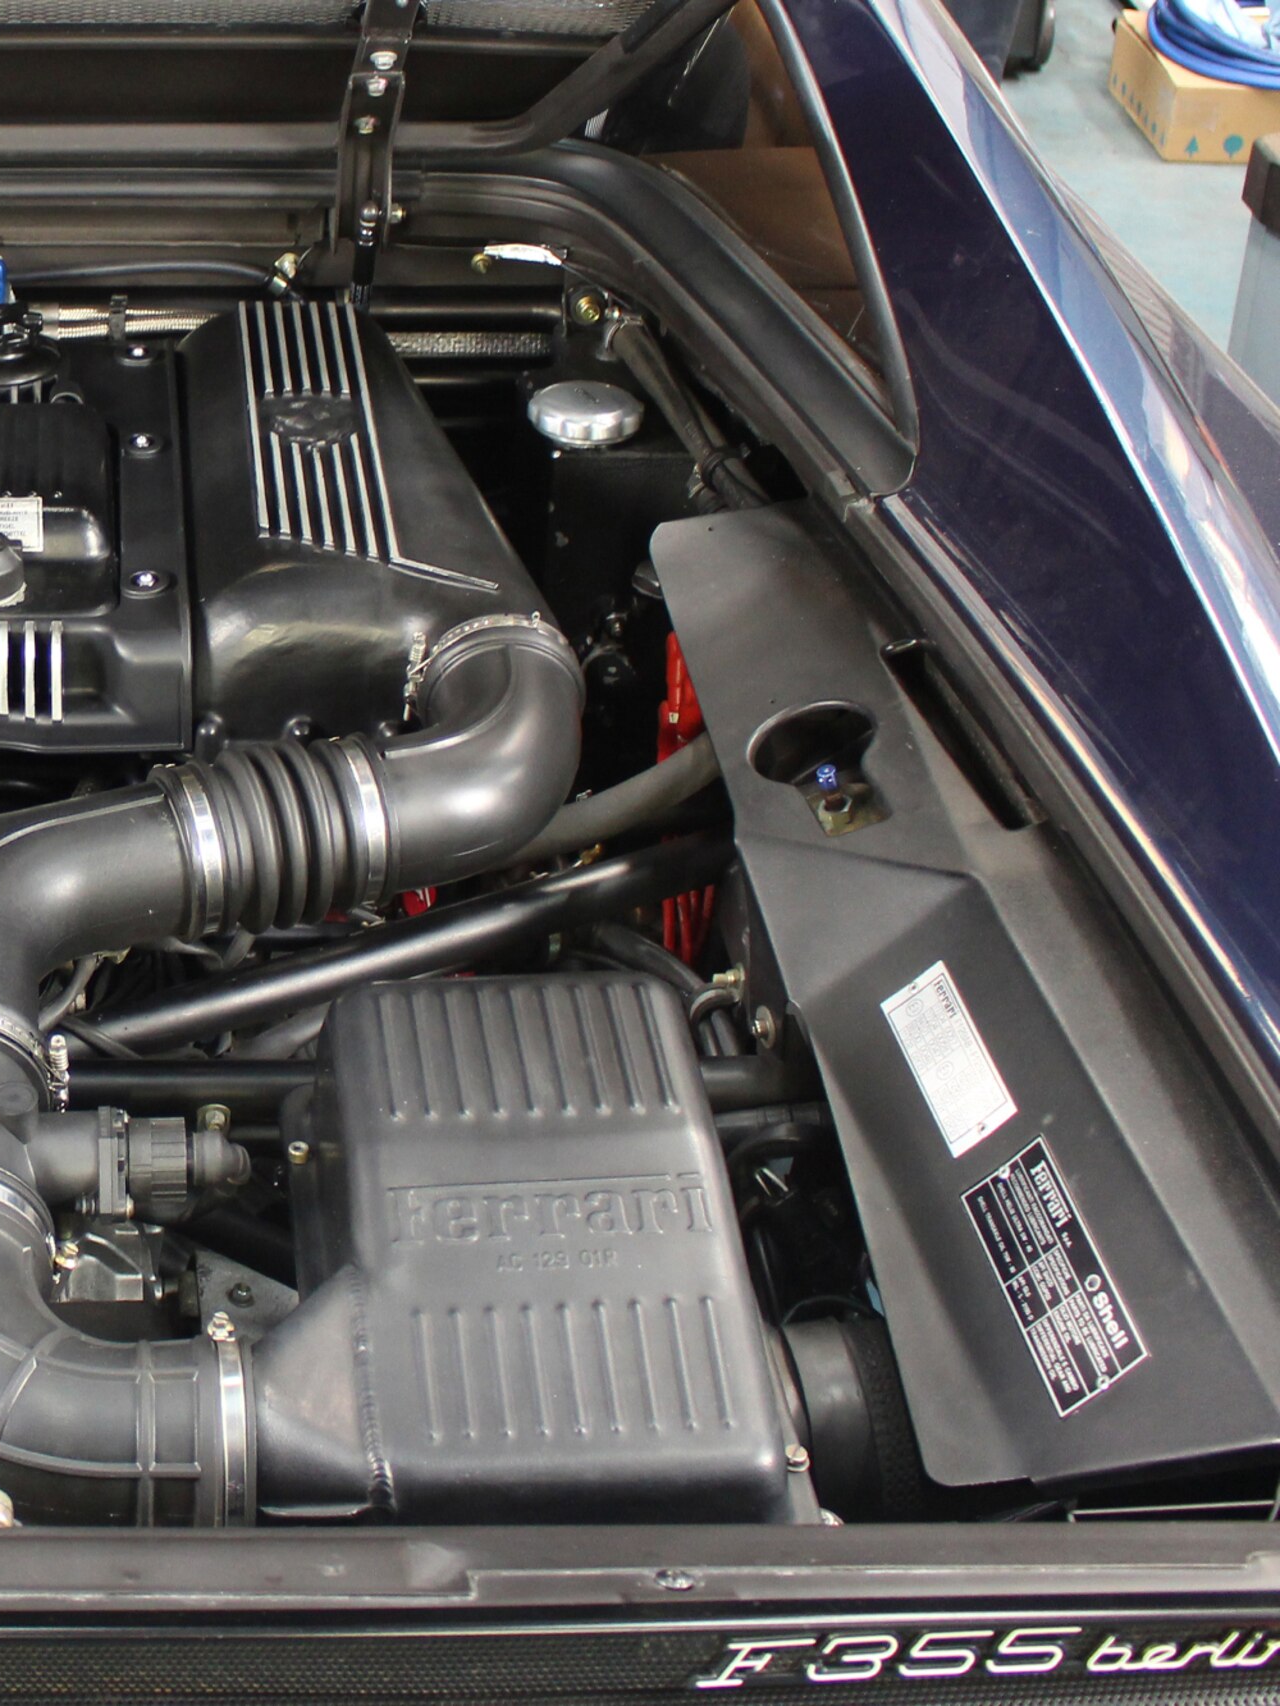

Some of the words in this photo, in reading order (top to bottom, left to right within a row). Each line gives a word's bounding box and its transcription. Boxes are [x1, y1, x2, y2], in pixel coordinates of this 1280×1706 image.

[387, 1172, 713, 1246] Ferrari
[1029, 1159, 1072, 1227] Ferrari
[1091, 1290, 1129, 1351] Shell
